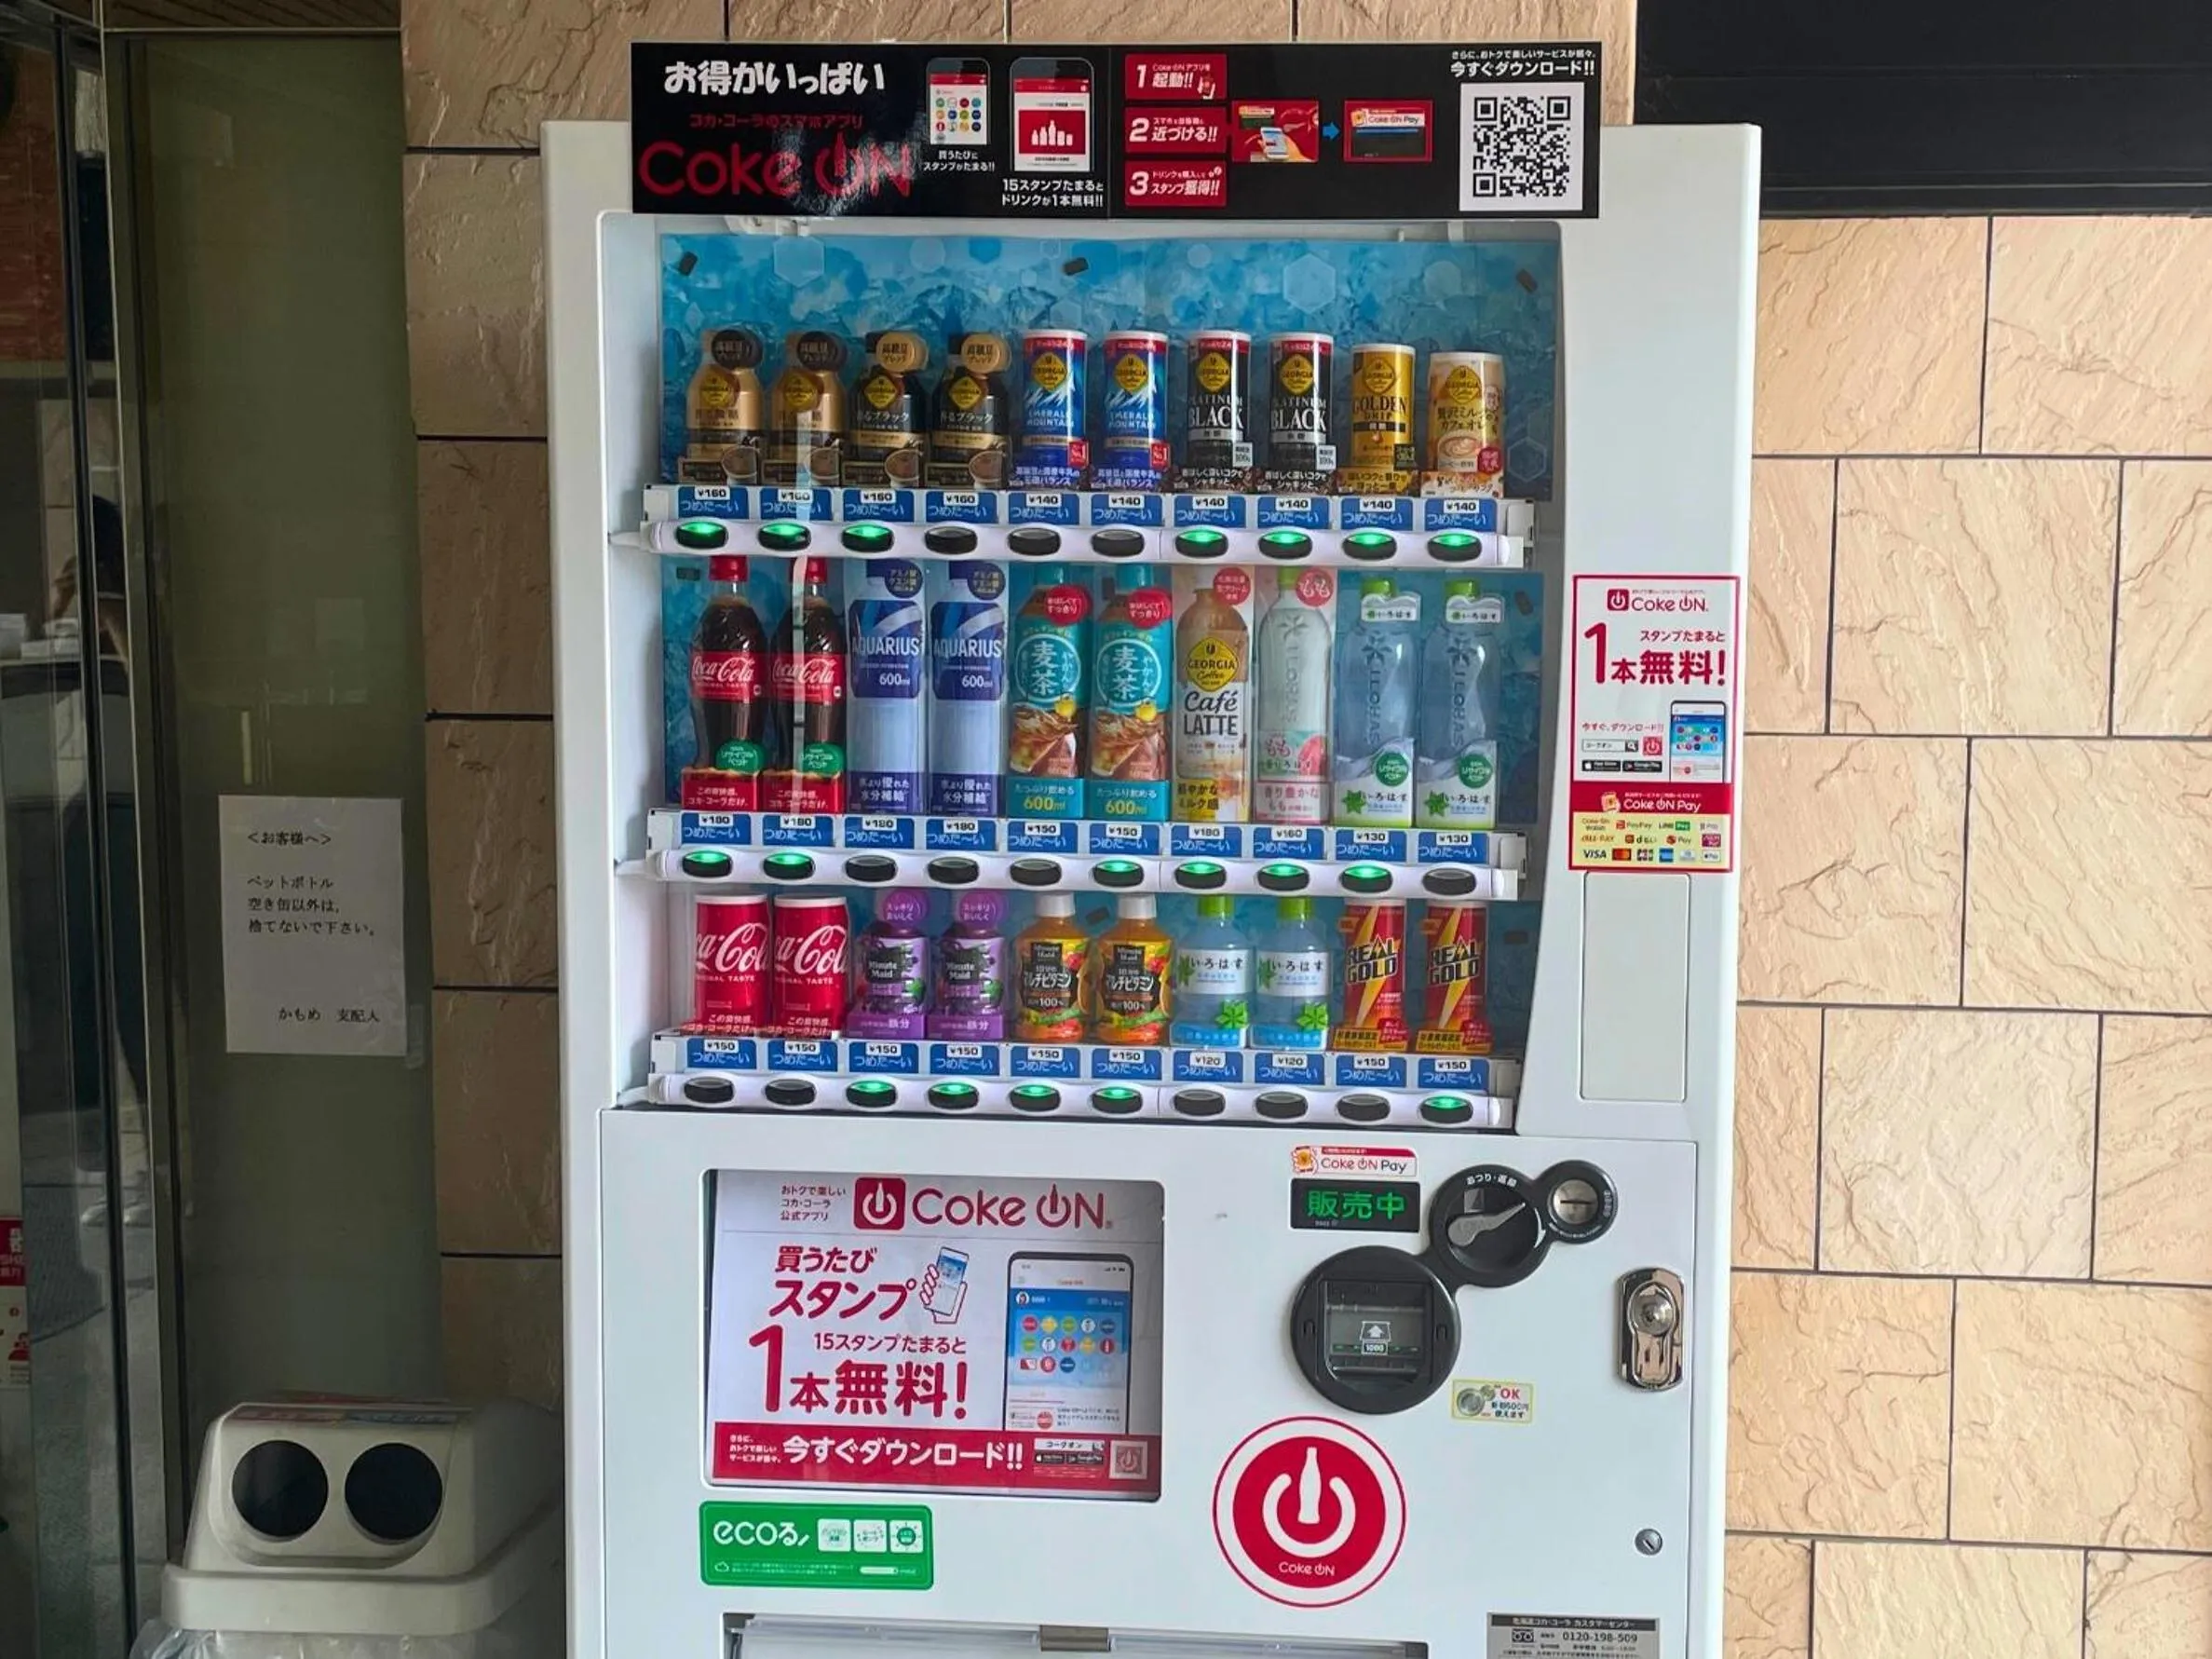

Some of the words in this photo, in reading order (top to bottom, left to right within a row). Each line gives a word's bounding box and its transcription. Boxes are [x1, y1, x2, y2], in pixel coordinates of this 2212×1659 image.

[663, 60, 885, 95] お得がいっぱい
[1136, 64, 1147, 88] 1
[1451, 61, 1595, 77] 今すぐダウンロード!!
[1129, 117, 1149, 143] 2
[1151, 126, 1218, 143] 近づける!!
[638, 140, 802, 197] Coke
[1002, 179, 1104, 192] 15スタンプたまると
[1129, 170, 1149, 196] 3
[1002, 194, 1104, 208] ドリンクが1本無料!!
[1188, 406, 1244, 429] BLACK
[1271, 408, 1327, 432] BLACK
[1631, 596, 1676, 612] Coke
[851, 636, 920, 657] AQUARIUS
[1640, 630, 1726, 643] スタンプたまると
[933, 638, 1002, 659] AQUARIUS
[1583, 621, 1727, 686] 1本無料!
[1031, 641, 1058, 697] 麦茶
[1112, 646, 1140, 700] 麦茶
[1188, 659, 1236, 670] GEORGIA
[1184, 690, 1238, 713] Café
[1184, 714, 1239, 737] LATTE
[1623, 798, 1655, 810] Coke
[1677, 799, 1702, 813] Pay
[1583, 849, 1608, 860] VISA
[247, 876, 334, 891] ペットボトル
[1347, 957, 1398, 986] GOLD
[1429, 959, 1479, 987] GOLD
[278, 1009, 321, 1022] かもめ
[337, 1008, 380, 1024] 支配人
[1321, 1157, 1355, 1171] Coke
[1380, 1159, 1407, 1175] Pay
[780, 1185, 847, 1197] おトクで楽しい
[780, 1198, 832, 1208] コカ・コーラ
[912, 1188, 1026, 1227] Coke
[1036, 1183, 1104, 1230] ON
[1306, 1190, 1405, 1221] 販売中
[780, 1211, 830, 1221] 公式アプリ
[775, 1244, 877, 1273] 買うたび
[768, 1277, 917, 1321] スタンプ
[813, 1332, 967, 1355] 15スタンプたまると
[748, 1324, 968, 1421] 1本無料!
[1500, 1387, 1521, 1400] OK
[783, 1435, 1024, 1471] 今すぐダウンロード!!
[1278, 1561, 1312, 1574] Coke
[1314, 1560, 1336, 1577] ON
[1562, 1631, 1638, 1643] 0120-198-509
